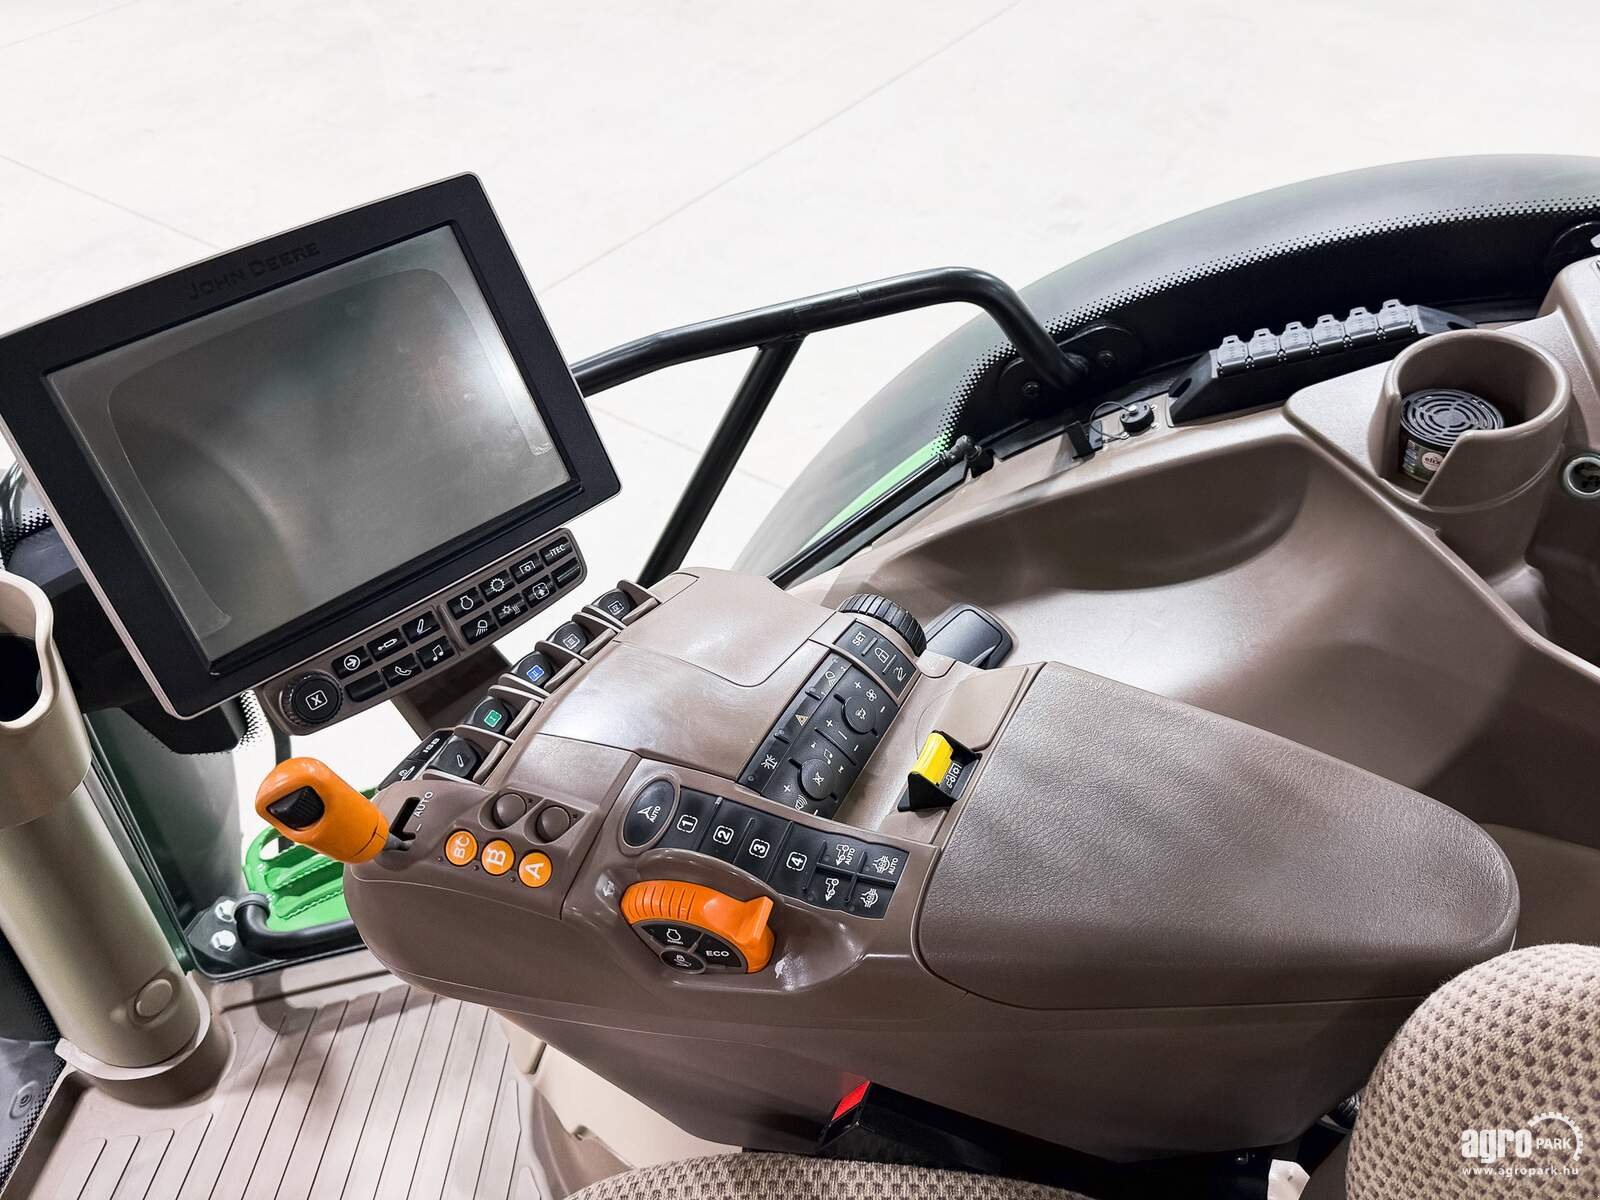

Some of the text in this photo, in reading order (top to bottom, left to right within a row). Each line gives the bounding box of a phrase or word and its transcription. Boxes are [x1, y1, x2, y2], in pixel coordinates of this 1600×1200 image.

[189, 242, 321, 300] JOHN DEERE
[852, 632, 866, 646] SET
[414, 791, 434, 818] AUTO
[650, 805, 661, 823] AUTO
[717, 830, 731, 840] 2
[454, 836, 470, 859] BC
[753, 843, 766, 854] 3
[845, 847, 855, 866] AUTO
[486, 849, 506, 867] B
[791, 856, 804, 867] 4
[888, 857, 899, 875] AUTO
[524, 862, 544, 880] A
[706, 950, 730, 958] ECO
